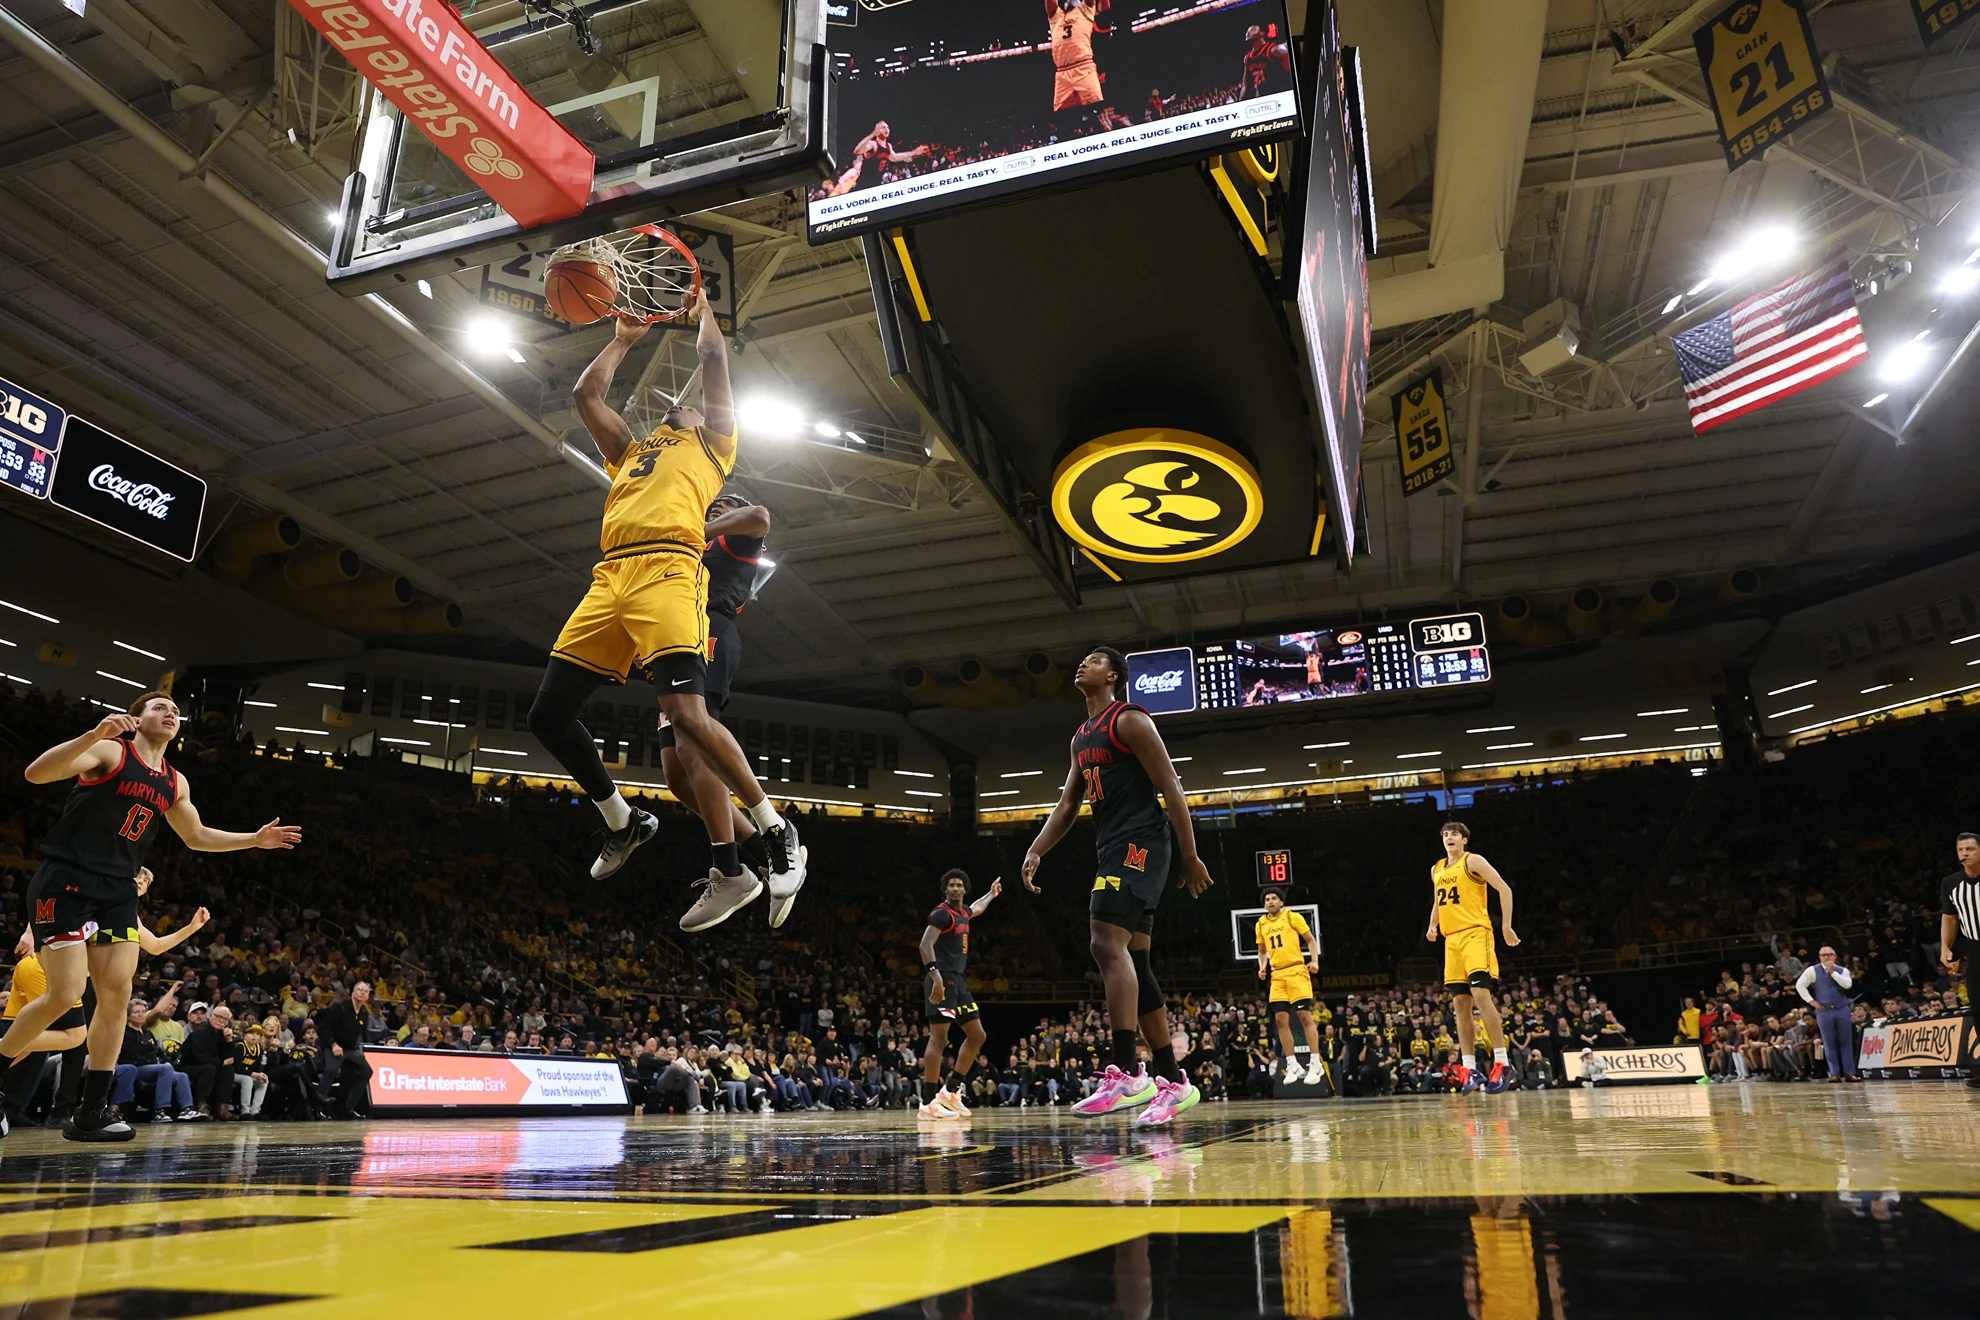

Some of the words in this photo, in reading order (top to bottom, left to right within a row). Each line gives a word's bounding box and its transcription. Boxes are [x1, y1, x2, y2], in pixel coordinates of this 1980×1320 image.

[1062, 25, 1073, 39] 3
[1736, 32, 1768, 60] CAIN
[1729, 41, 1795, 117] 21
[1230, 119, 1294, 139] #FightForIowa
[1730, 89, 1824, 161] 1954-56
[1043, 151, 1069, 163] REAL
[1111, 135, 1138, 148] REAL
[1175, 121, 1202, 133] REAL
[820, 204, 844, 215] REAL
[881, 189, 905, 201] REAL
[939, 175, 964, 186] REAL
[815, 215, 869, 233] #FightForIowa
[1406, 416, 1443, 461] 55
[28, 461, 46, 481] 33
[629, 449, 663, 478] 3
[88, 464, 176, 520] Coca-Cola
[1082, 766, 1105, 804] 21
[1376, 774, 1420, 790] IOWA
[118, 803, 153, 841] 13
[1123, 843, 1149, 873] M
[1269, 864, 1286, 881] 18
[1437, 886, 1460, 907] 24
[34, 898, 56, 924] M
[1269, 934, 1283, 949] 11
[1889, 1024, 1957, 1064] PANCHEROS
[397, 1075, 426, 1091] First
[536, 1068, 561, 1081] Proud
[563, 1071, 593, 1084] sponsor
[594, 1070, 602, 1082] of
[602, 1070, 615, 1082] the
[541, 1086, 562, 1097] Iowa
